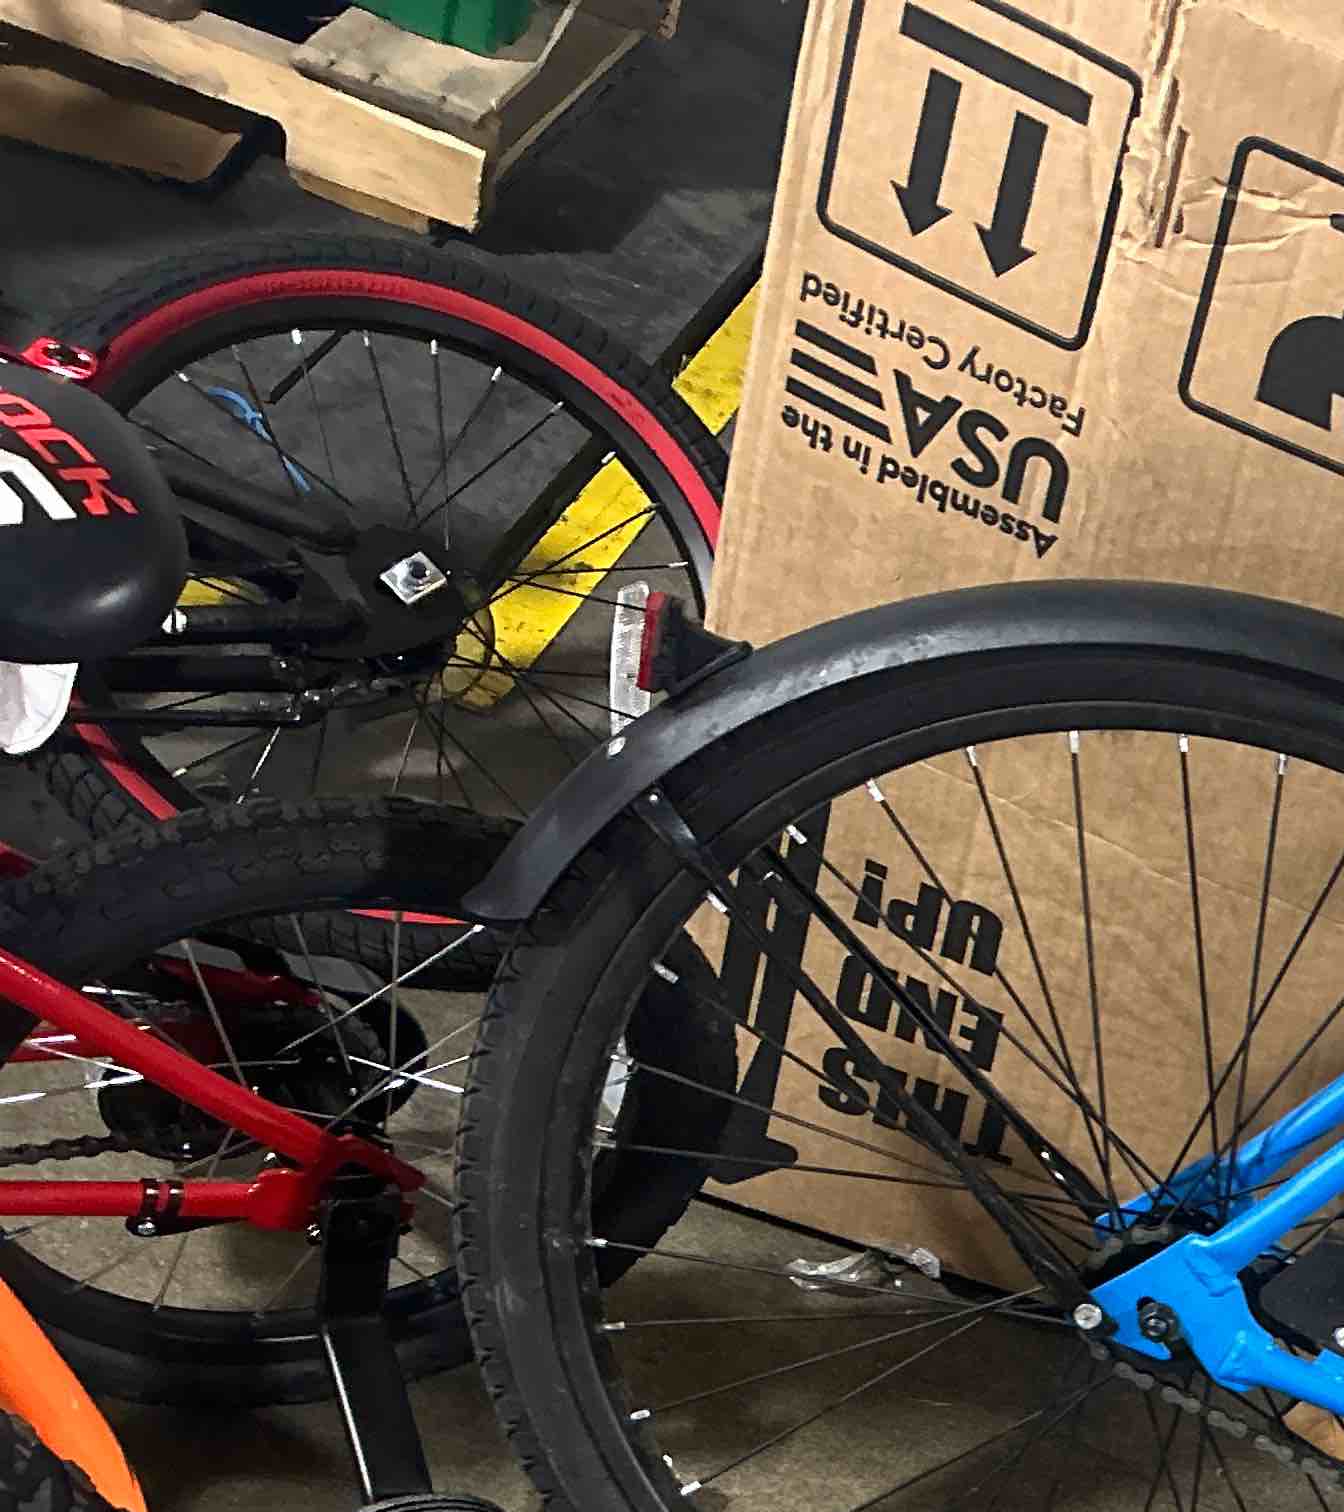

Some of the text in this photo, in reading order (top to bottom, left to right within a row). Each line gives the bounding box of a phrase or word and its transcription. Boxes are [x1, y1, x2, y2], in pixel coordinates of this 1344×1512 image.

[800, 272, 1086, 437] Factory Certified
[781, 405, 1058, 558] Assembled in the
[893, 369, 1070, 524] USA
[853, 858, 1003, 977] UP!
[836, 954, 1004, 1072] END
[818, 1047, 1012, 1167] THIS
